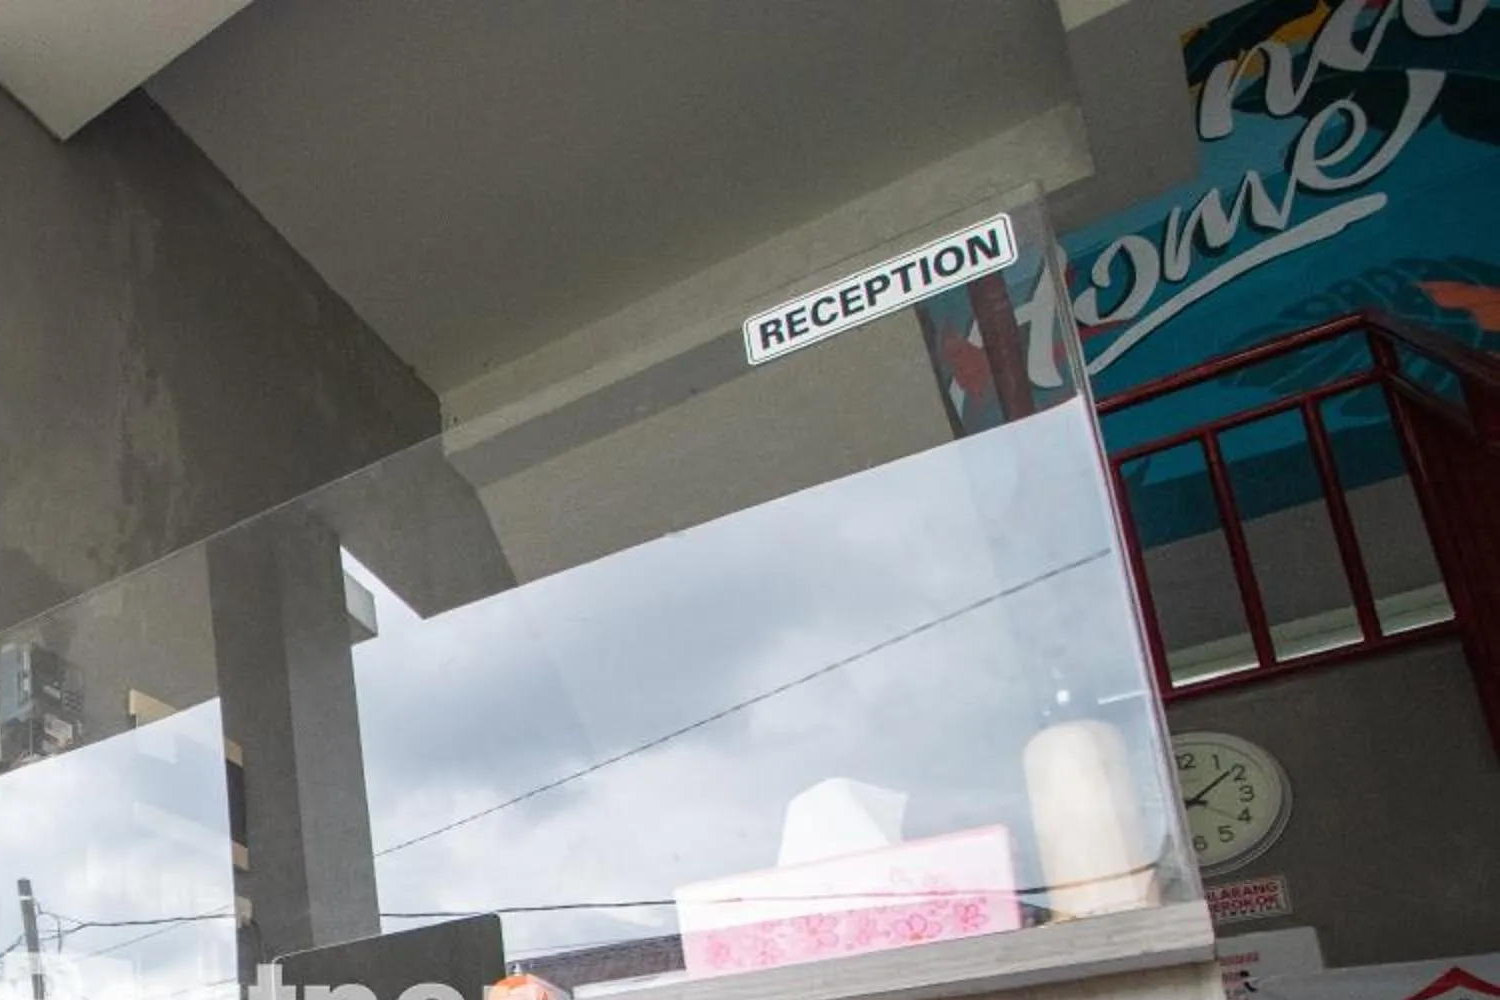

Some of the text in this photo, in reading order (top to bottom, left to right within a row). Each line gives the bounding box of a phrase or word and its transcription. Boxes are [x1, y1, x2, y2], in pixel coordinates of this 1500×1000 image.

[758, 228, 1002, 350] RECEPTION
[1211, 753, 1221, 771] 1
[1231, 763, 1247, 782] 2
[1238, 784, 1255, 802] 3
[1237, 807, 1253, 824] 4
[1192, 835, 1209, 852] 6
[1217, 825, 1235, 844] 5
[1205, 881, 1278, 902] ILARANG
[1207, 894, 1278, 913] EROKOK
